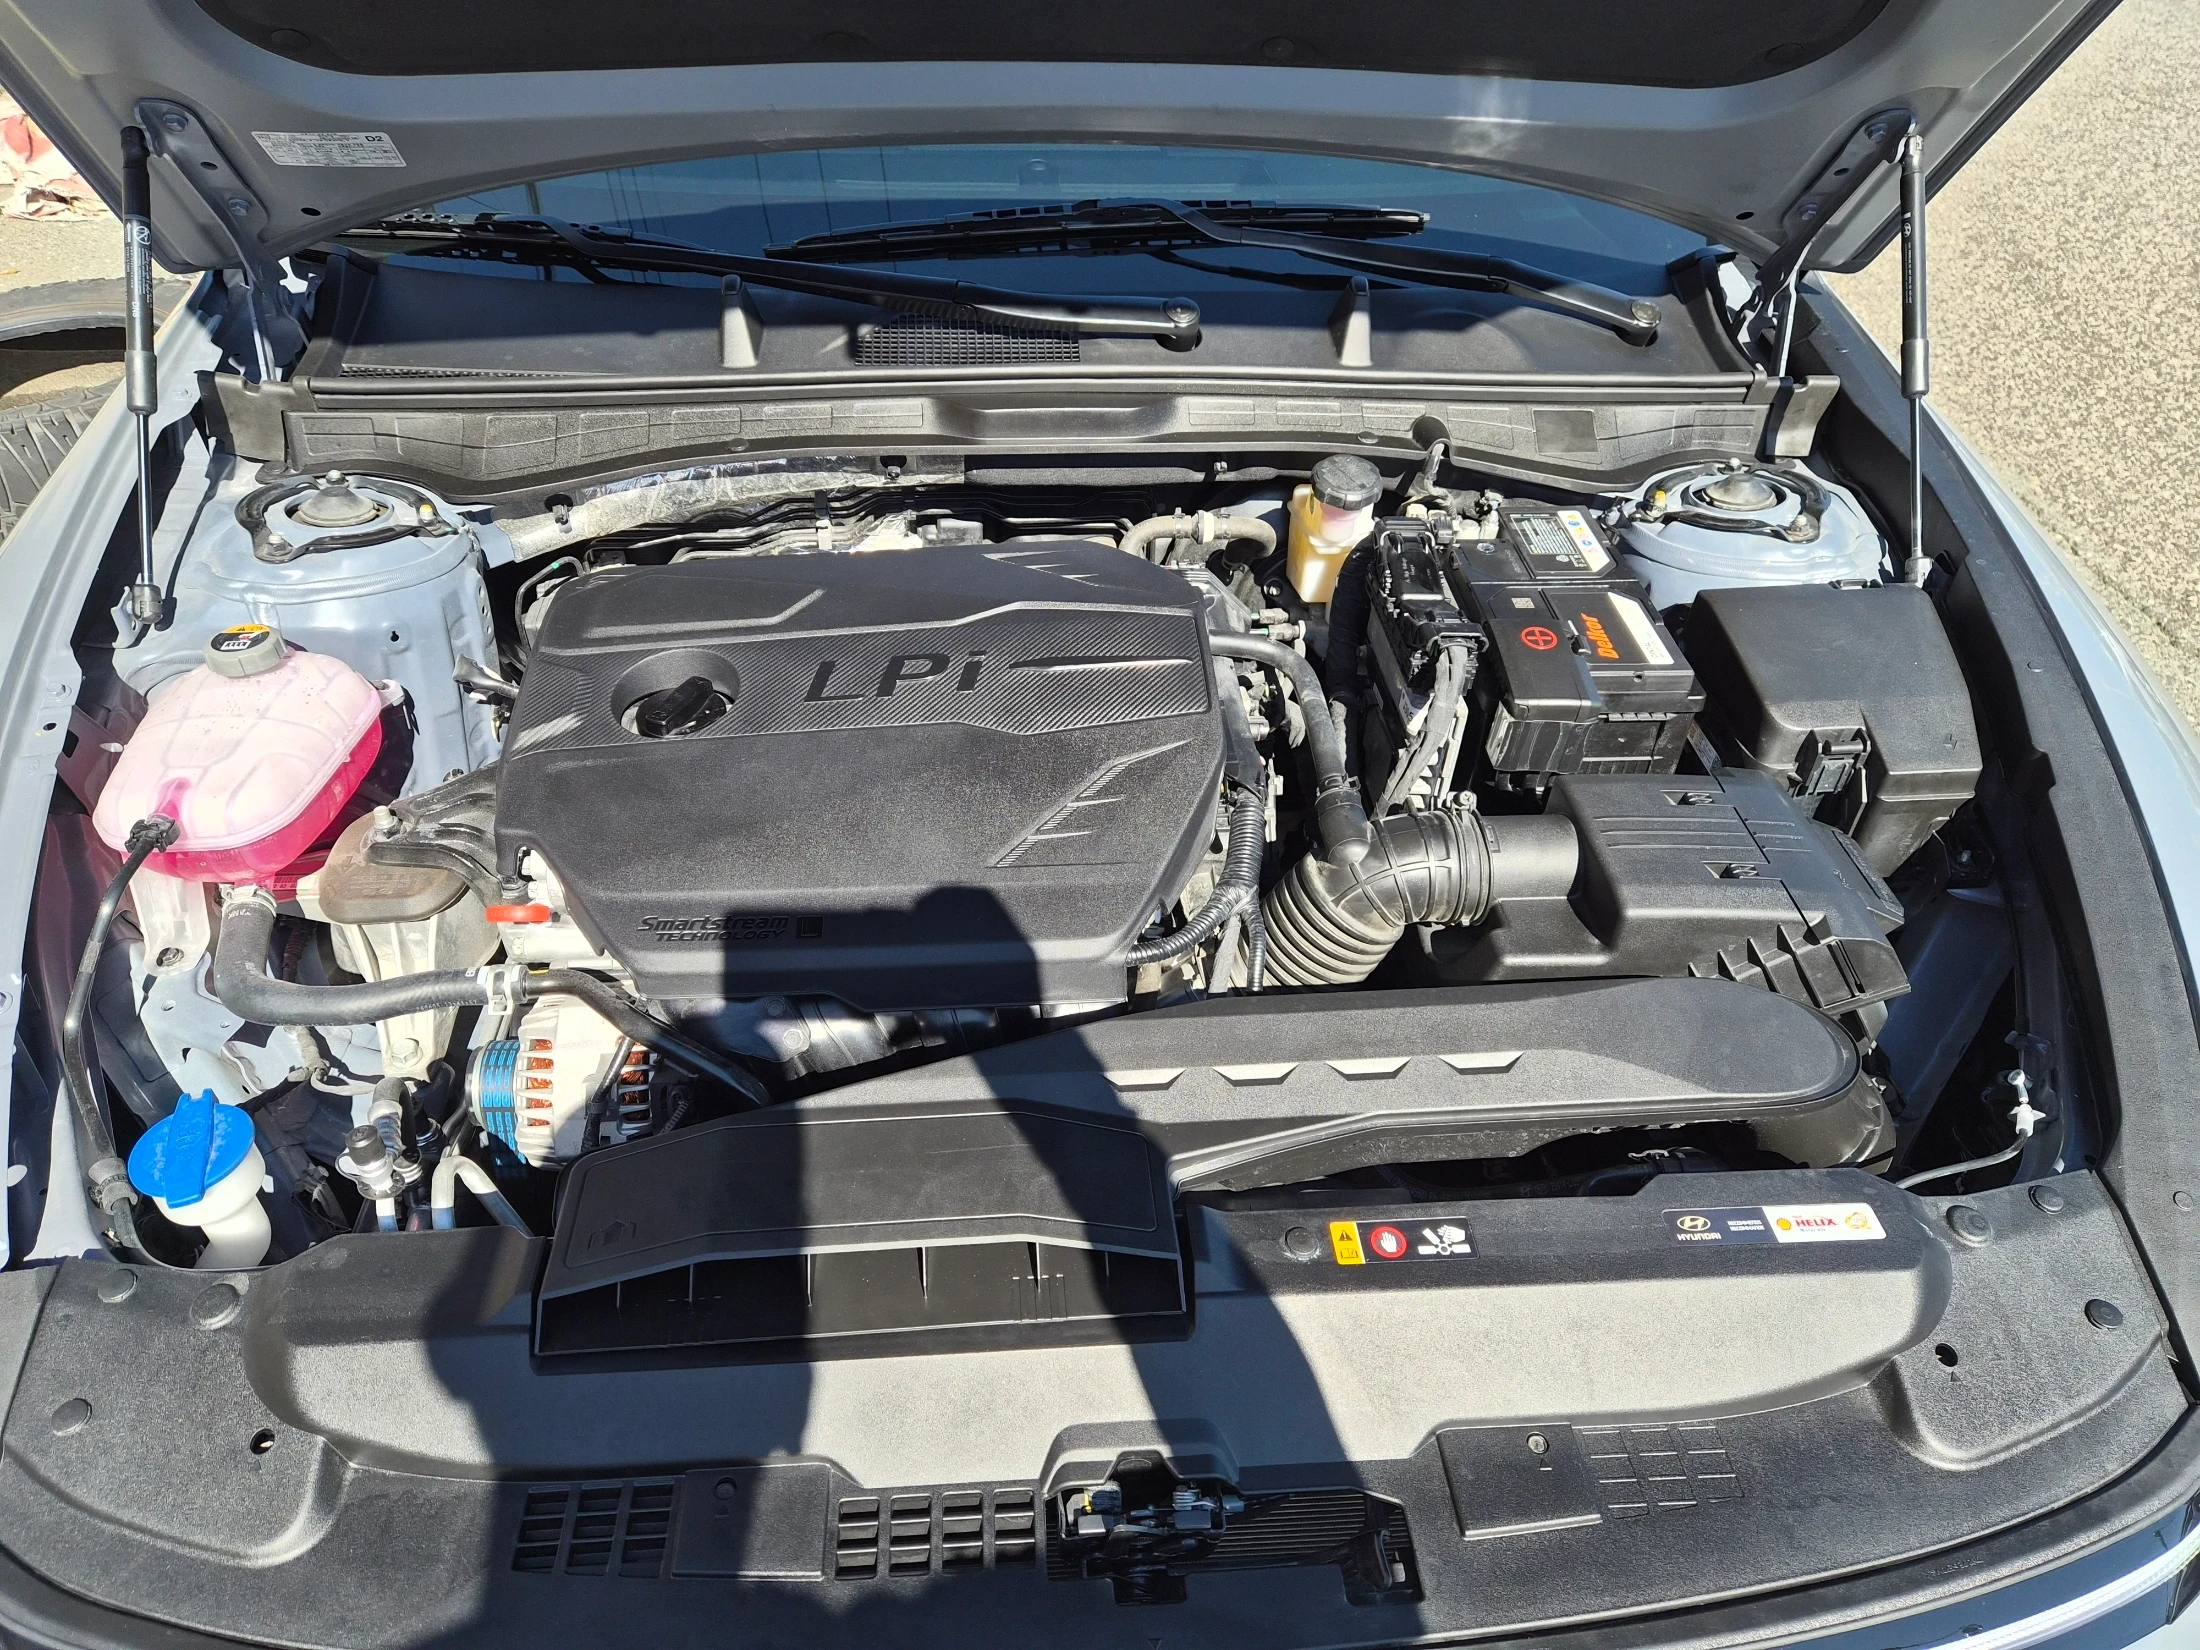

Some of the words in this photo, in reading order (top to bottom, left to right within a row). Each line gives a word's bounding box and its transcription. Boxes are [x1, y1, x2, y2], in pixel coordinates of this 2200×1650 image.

[1580, 612, 1620, 660] Delkor
[803, 651, 987, 702] LPi
[636, 915, 790, 932] Smartstream
[656, 930, 786, 942] TECHNOLOGY
[1795, 1218, 1838, 1227] HELIX
[1677, 1232, 1722, 1241] HYUNDAI
